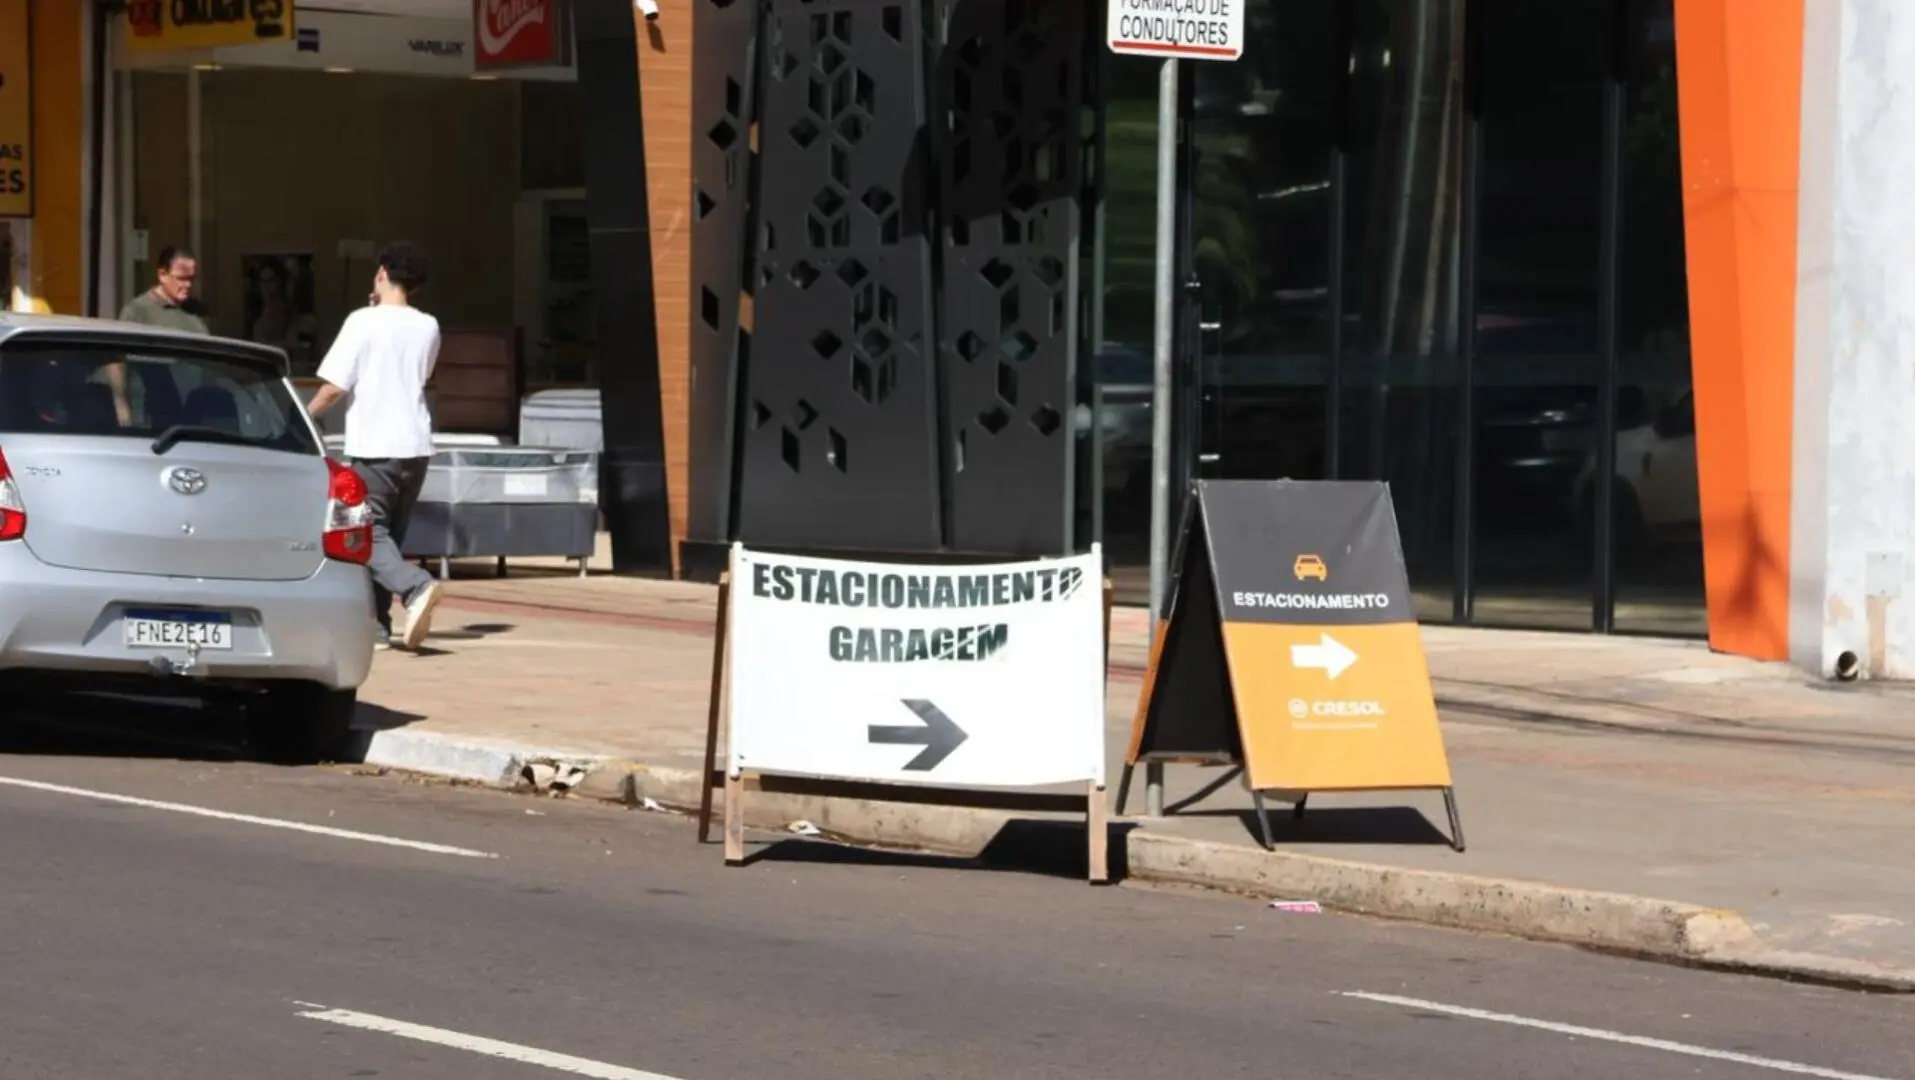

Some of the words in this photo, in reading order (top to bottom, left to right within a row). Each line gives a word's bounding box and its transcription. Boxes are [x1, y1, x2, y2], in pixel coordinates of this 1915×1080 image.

[1119, 14, 1229, 45] CONDUTORES
[752, 562, 1084, 608] ESTACIONAMENTO
[1233, 592, 1389, 608] ESTACIONAMENTO
[136, 622, 222, 645] FNE2E16
[829, 623, 1009, 662] GARAGEM
[1313, 701, 1385, 716] CRESOL
